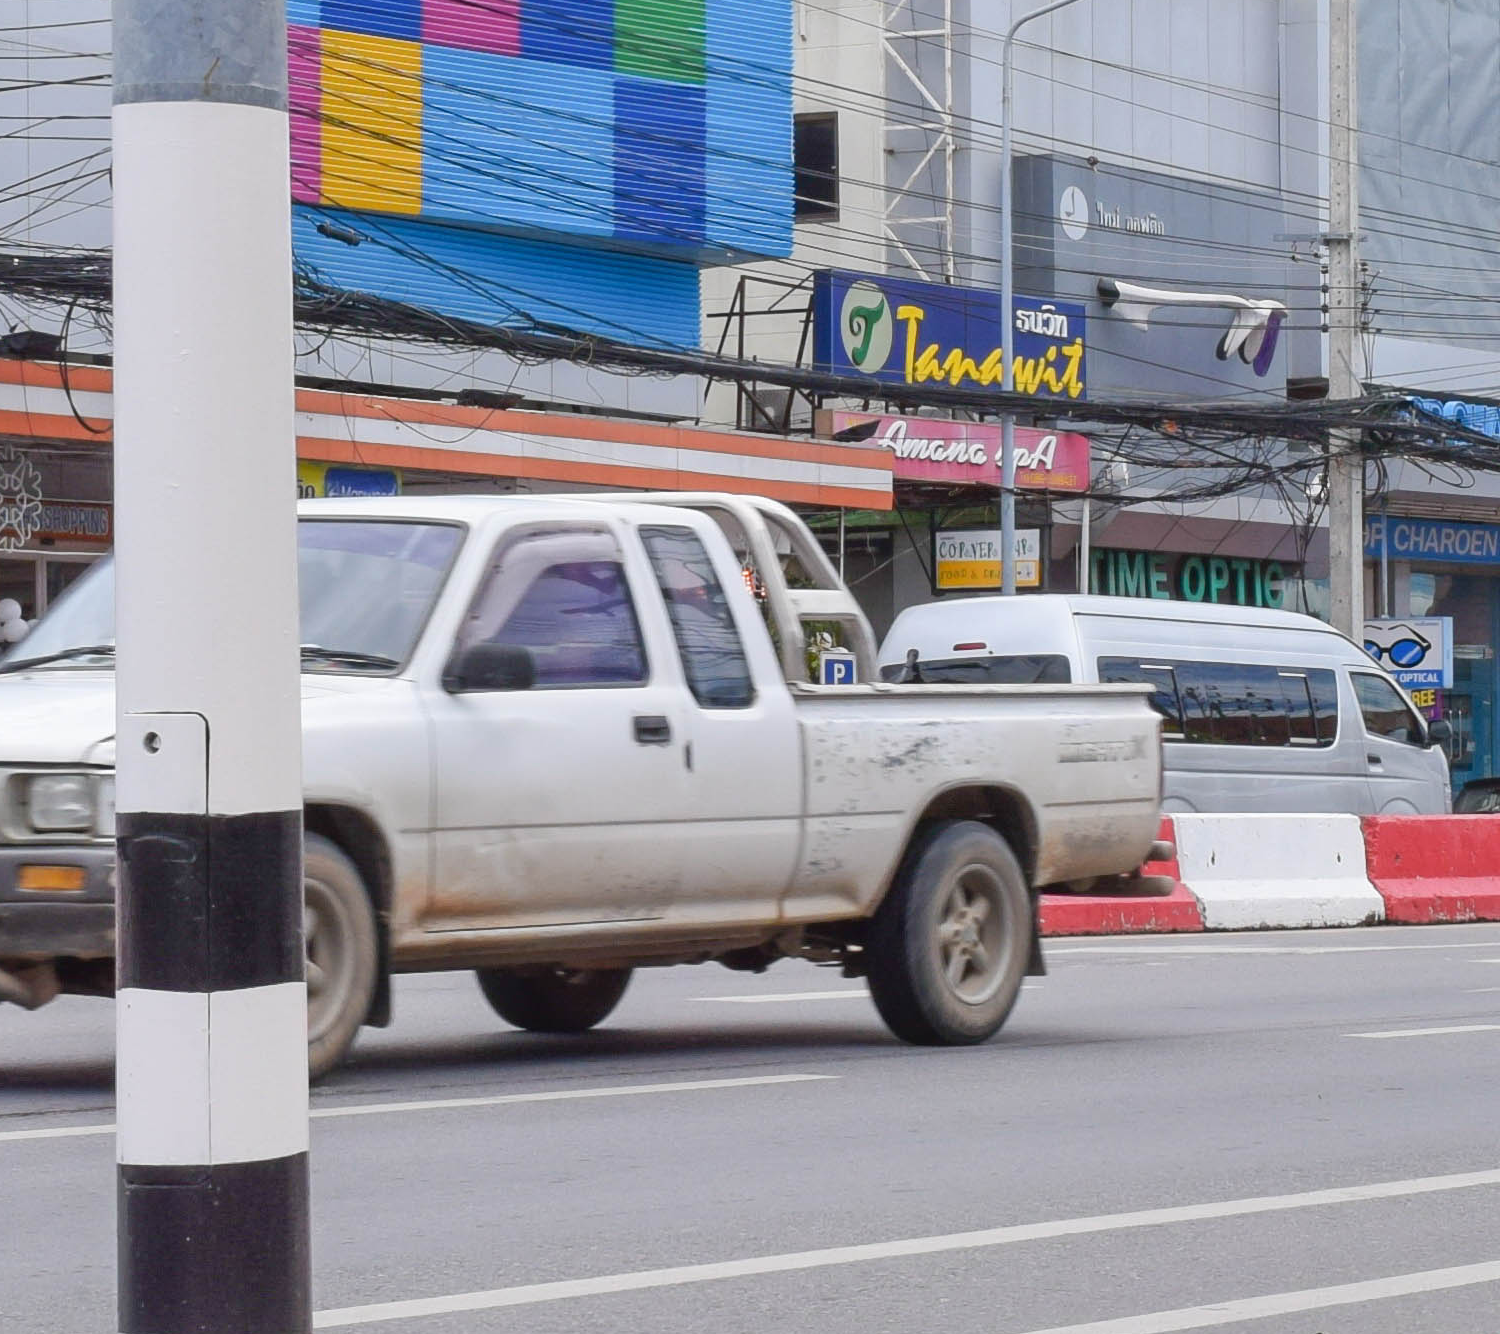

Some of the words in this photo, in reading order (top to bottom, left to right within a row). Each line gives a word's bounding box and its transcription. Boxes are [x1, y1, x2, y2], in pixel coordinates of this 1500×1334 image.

[896, 305, 1084, 399] Tanawit
[878, 420, 988, 466] Amana
[1393, 523, 1498, 556] CHAROEN
[1089, 548, 1171, 601] TIME
[1182, 555, 1286, 609] OPTIC
[833, 663, 846, 684] P
[1399, 672, 1439, 683] OPTICAL
[1411, 689, 1436, 707] REE
